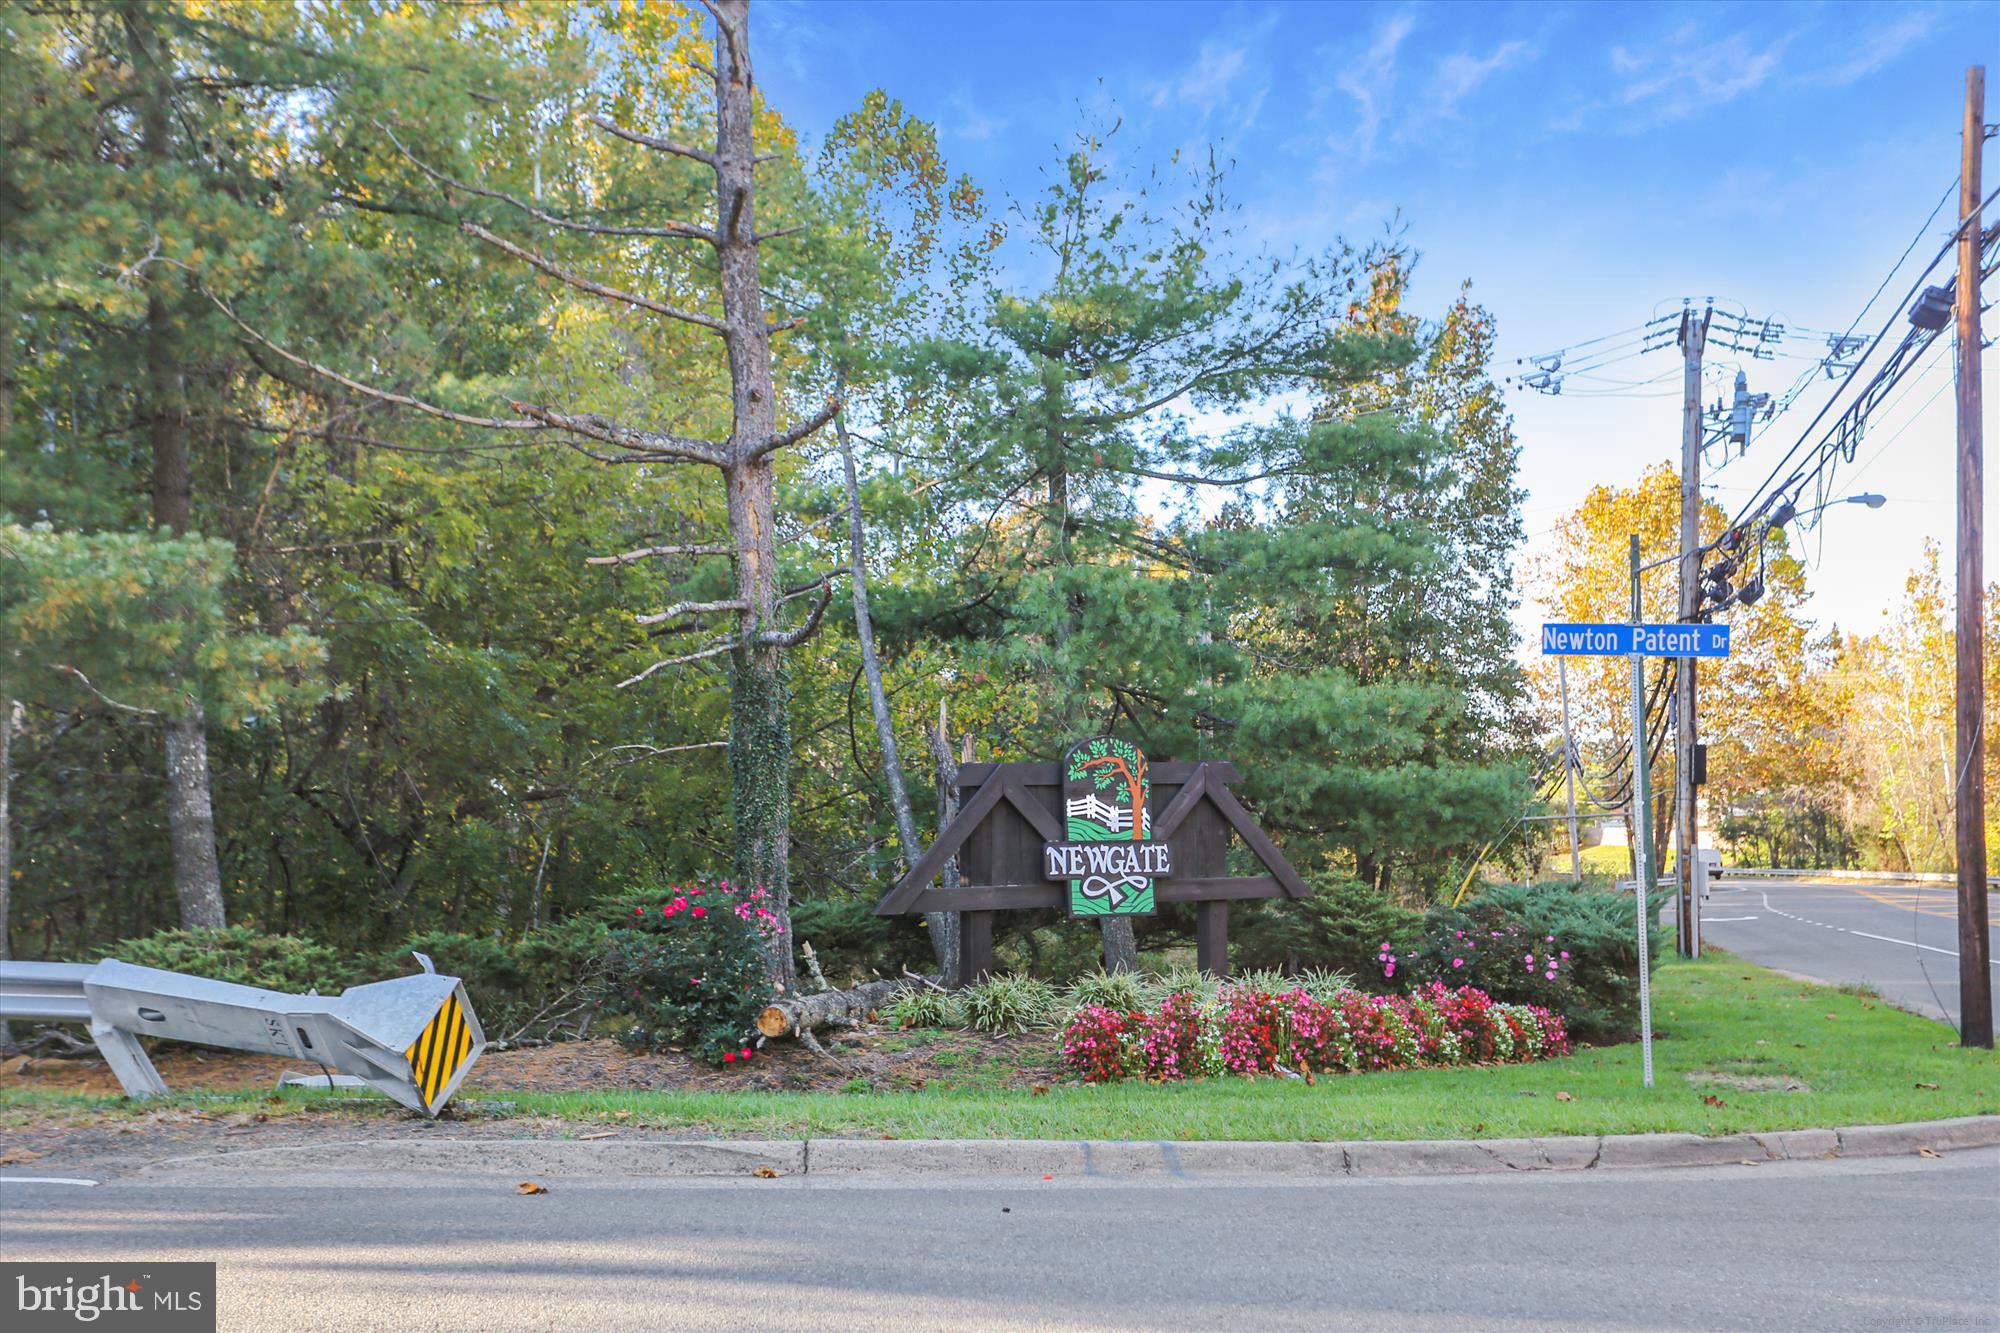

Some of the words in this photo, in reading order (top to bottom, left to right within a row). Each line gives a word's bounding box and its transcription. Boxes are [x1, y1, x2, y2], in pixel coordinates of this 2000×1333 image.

[1543, 627, 1618, 651] Newton
[1632, 627, 1701, 652] Patent
[1712, 635, 1727, 649] Dr
[1046, 843, 1170, 876] NEWGATE
